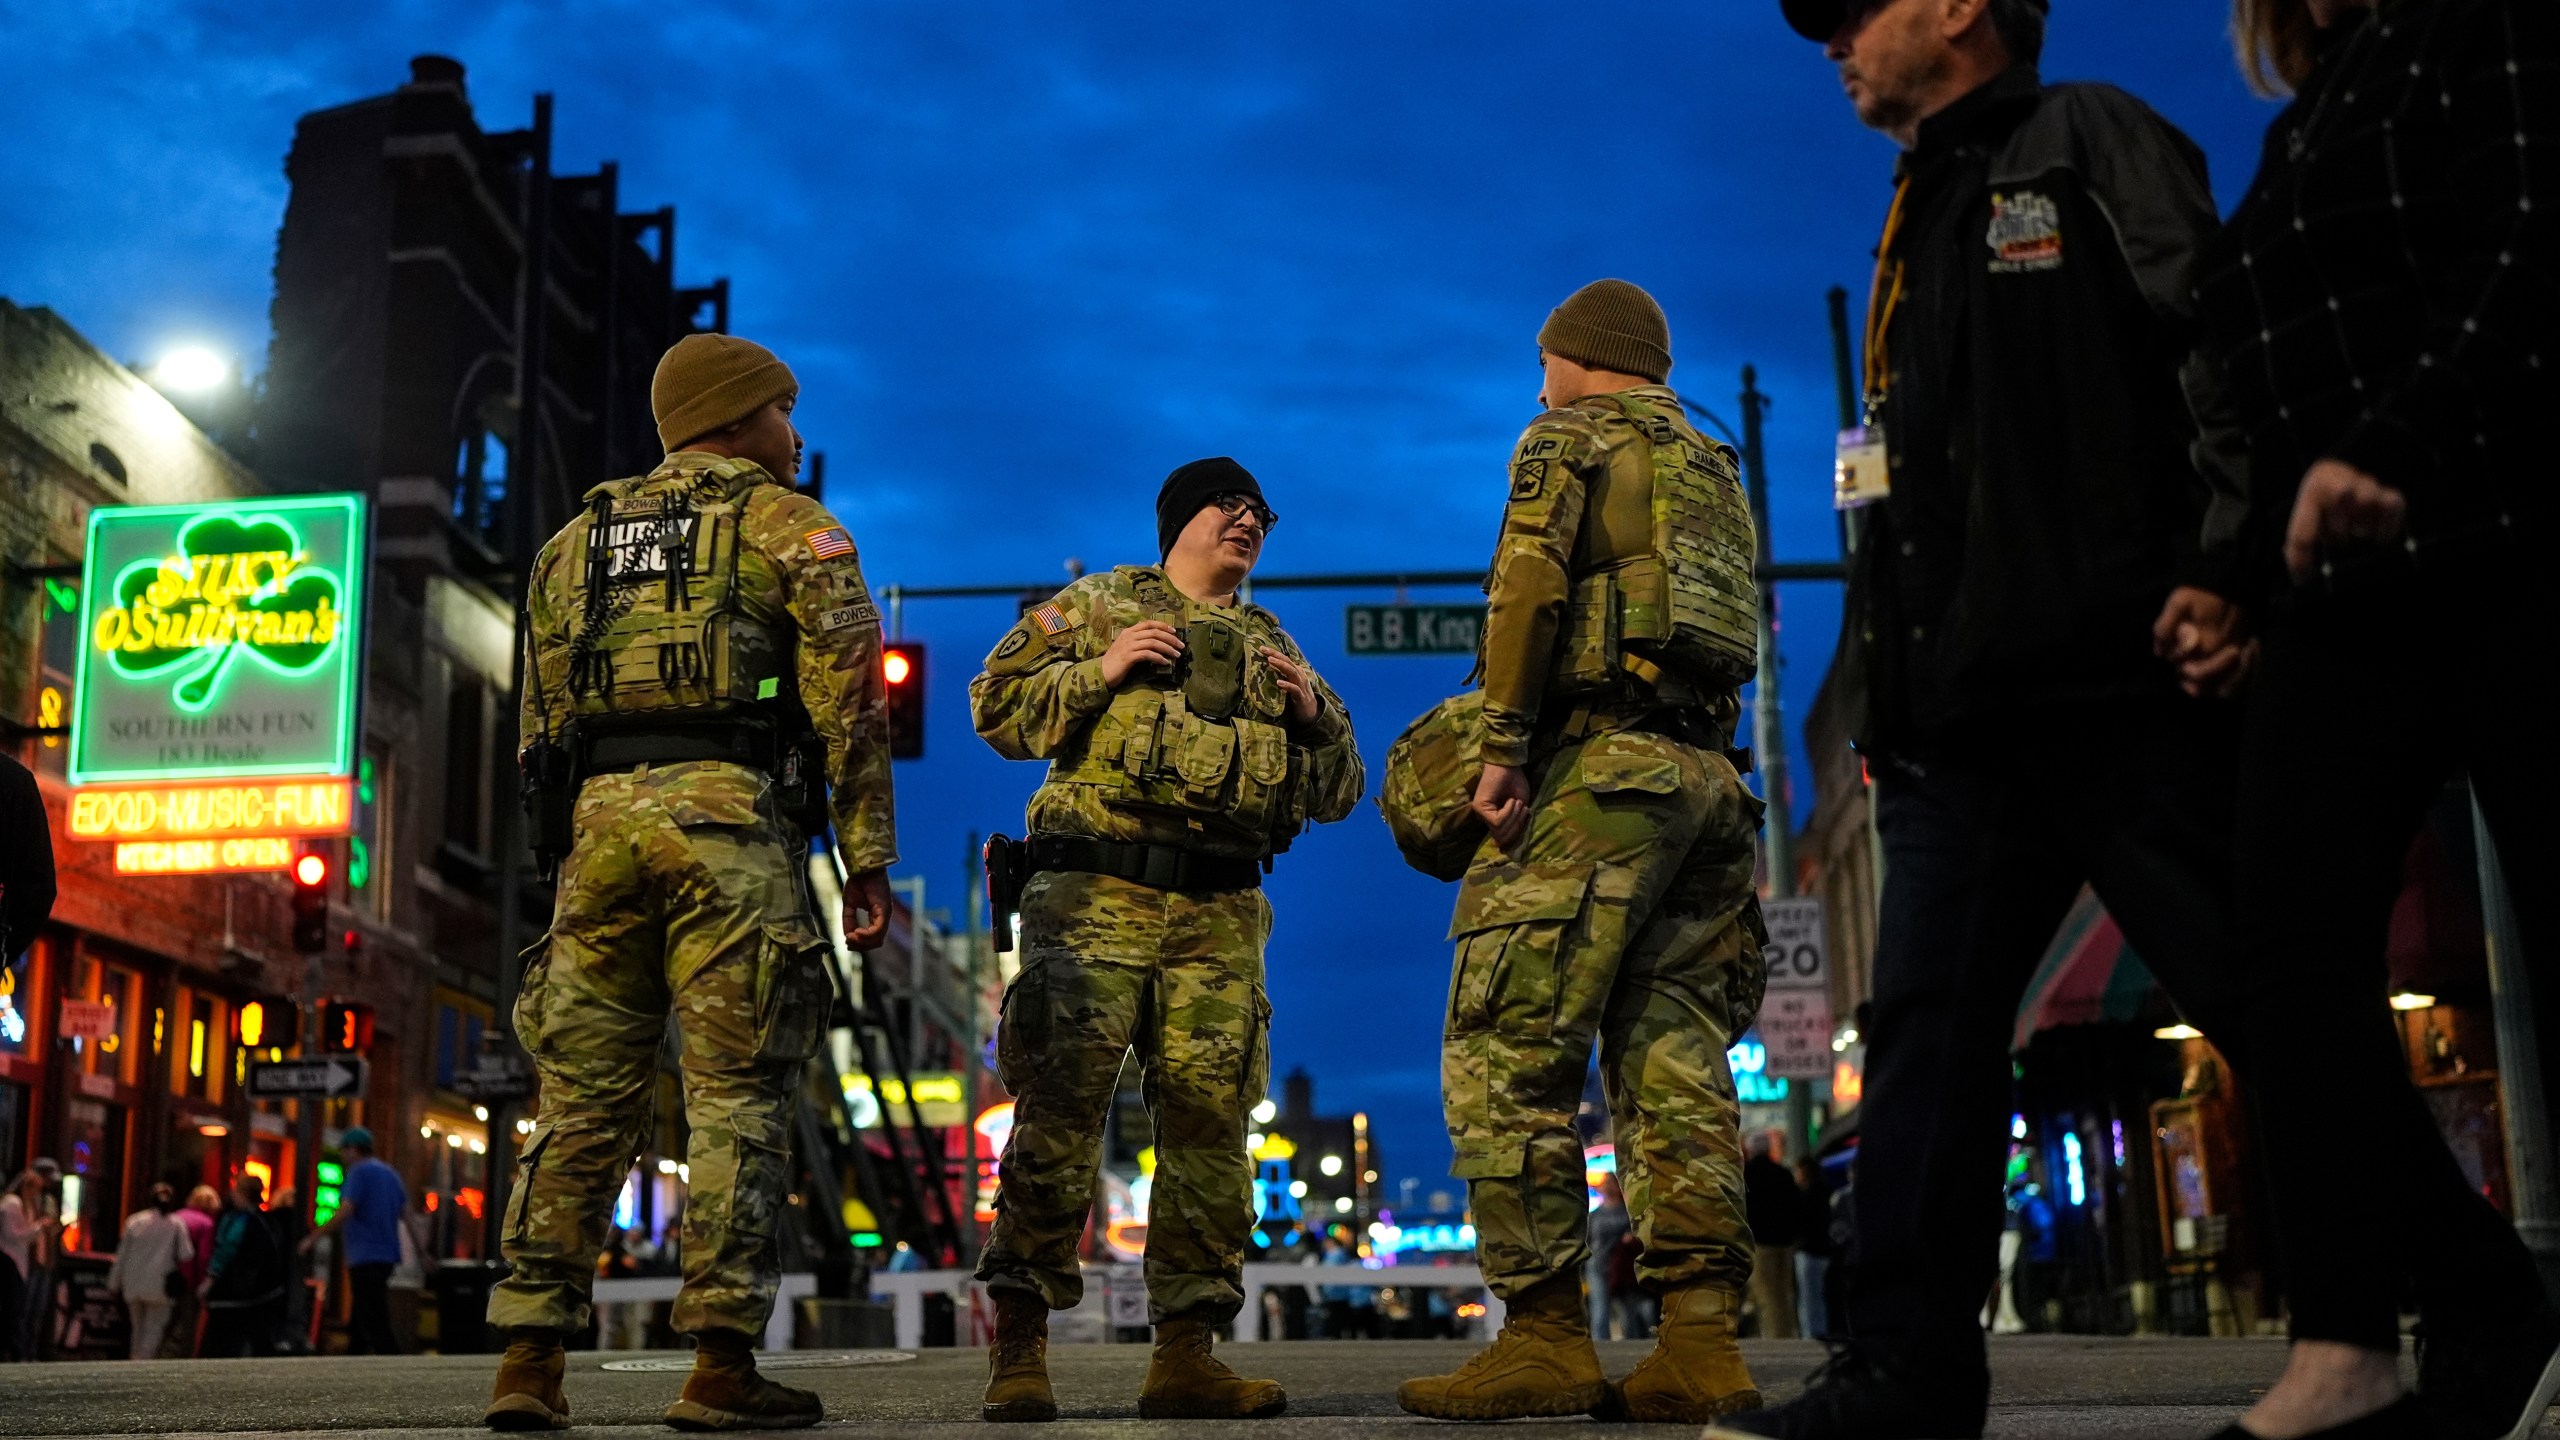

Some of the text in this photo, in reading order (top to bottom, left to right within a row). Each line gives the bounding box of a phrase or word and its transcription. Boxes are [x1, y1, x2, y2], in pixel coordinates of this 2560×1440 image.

[1520, 439, 1557, 461] MP
[624, 498, 664, 511] BOWEN
[832, 605, 877, 625] BOWENS
[109, 710, 318, 743] SOUTHERN FUN
[116, 837, 290, 872] KITCHEN OPEN
[1764, 944, 1819, 977] 20
